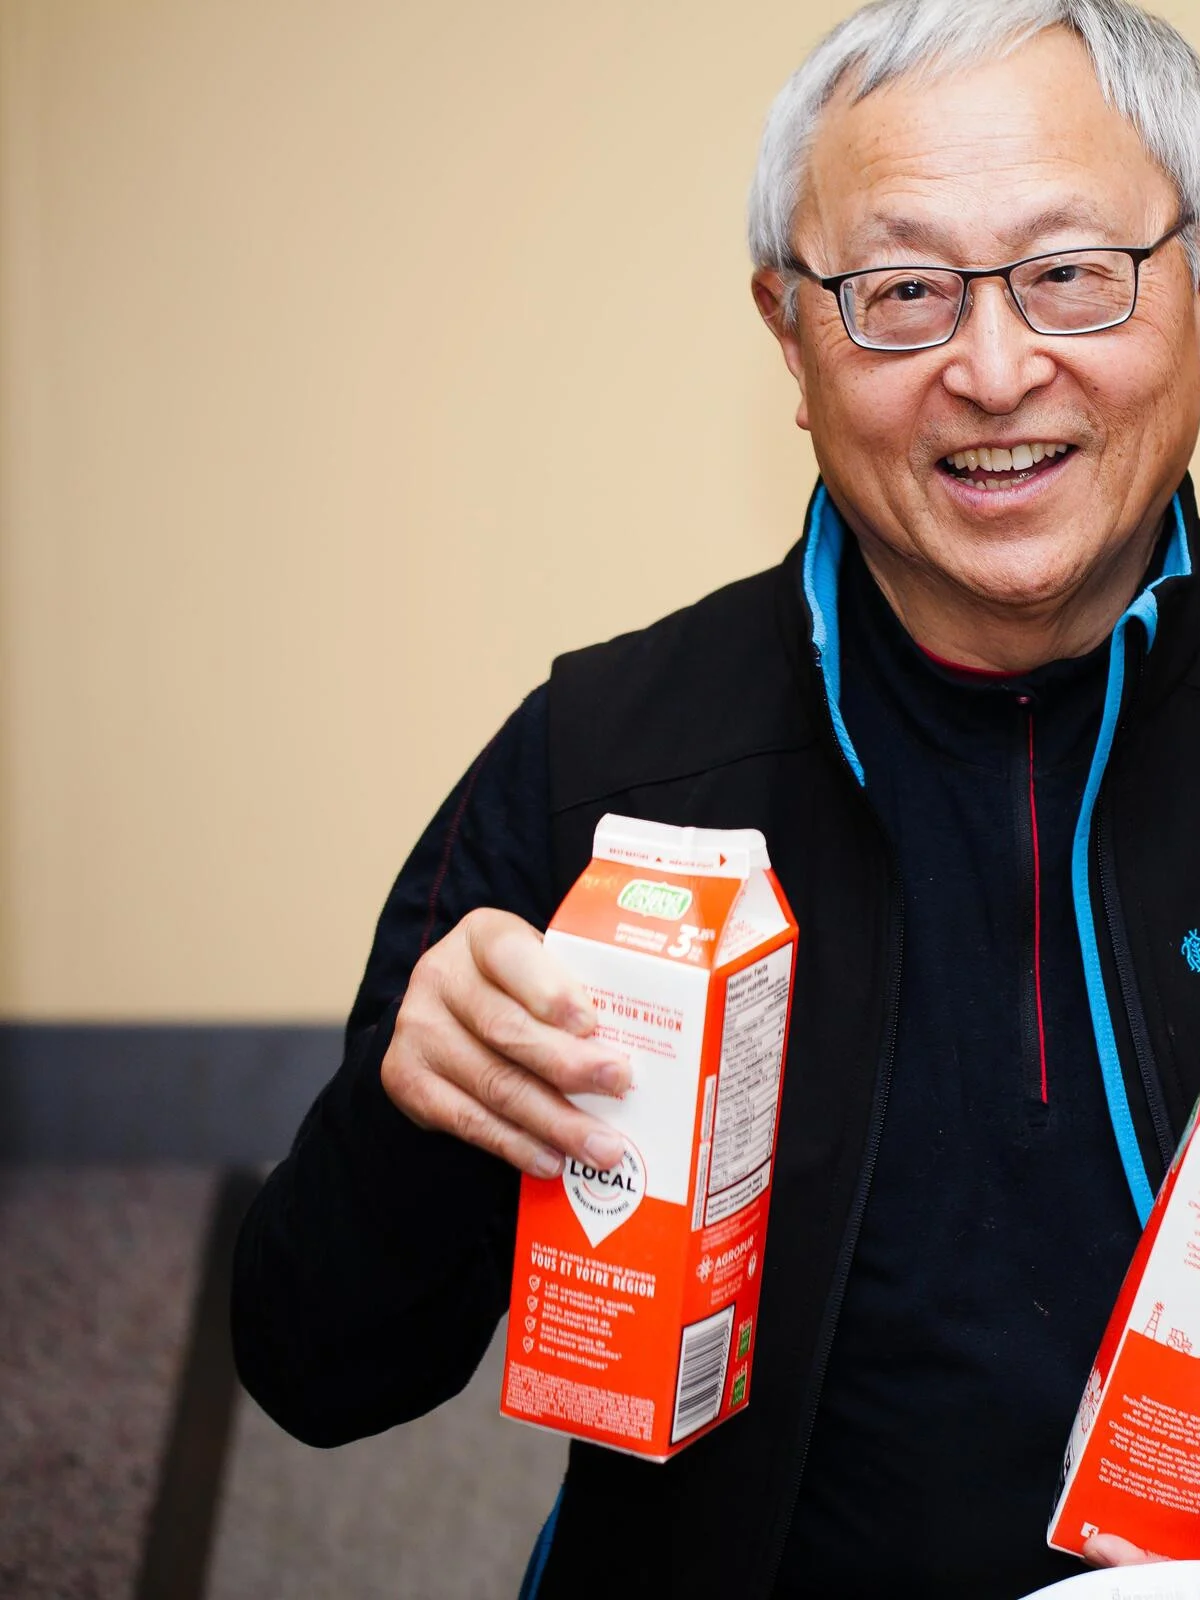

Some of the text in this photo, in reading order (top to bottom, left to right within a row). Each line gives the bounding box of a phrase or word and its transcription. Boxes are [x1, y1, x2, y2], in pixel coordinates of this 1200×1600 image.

[592, 997, 682, 1032] ND YOUR REGION
[570, 1158, 637, 1193] LOCAL
[532, 1242, 558, 1257] ISLAND
[714, 1235, 754, 1271] AGROPUR
[531, 1251, 556, 1271] VOUS
[560, 1260, 572, 1276] ET
[576, 1265, 609, 1286] VOTRE
[1141, 1395, 1177, 1415] Savourez
[1178, 1411, 1188, 1419] au
[1109, 1420, 1135, 1437] Choisir
[1161, 1443, 1188, 1459] Farms,
[1122, 1413, 1150, 1429] chaque
[1151, 1425, 1168, 1436] jour
[1169, 1432, 1184, 1441] par
[1184, 1437, 1199, 1446] des
[1142, 1413, 1194, 1438] de passion
[1110, 1439, 1128, 1451] c'est
[1129, 1447, 1147, 1459] faire
[1148, 1456, 1176, 1470] preuve
[1115, 1433, 1129, 1443] que
[1130, 1440, 1157, 1454] choisir
[1158, 1452, 1173, 1460] une
[1101, 1457, 1127, 1474] Choisir
[1153, 1479, 1180, 1494] Farms,
[1181, 1489, 1200, 1499] c'est
[1129, 1457, 1155, 1471] envers
[1157, 1467, 1178, 1478] votre
[1098, 1474, 1111, 1484] qui
[1112, 1481, 1148, 1499] participe
[1155, 1496, 1200, 1514] l'économie
[1109, 1470, 1122, 1481] lait
[1123, 1477, 1145, 1490] d'une
[1146, 1486, 1194, 1508] coopérative
